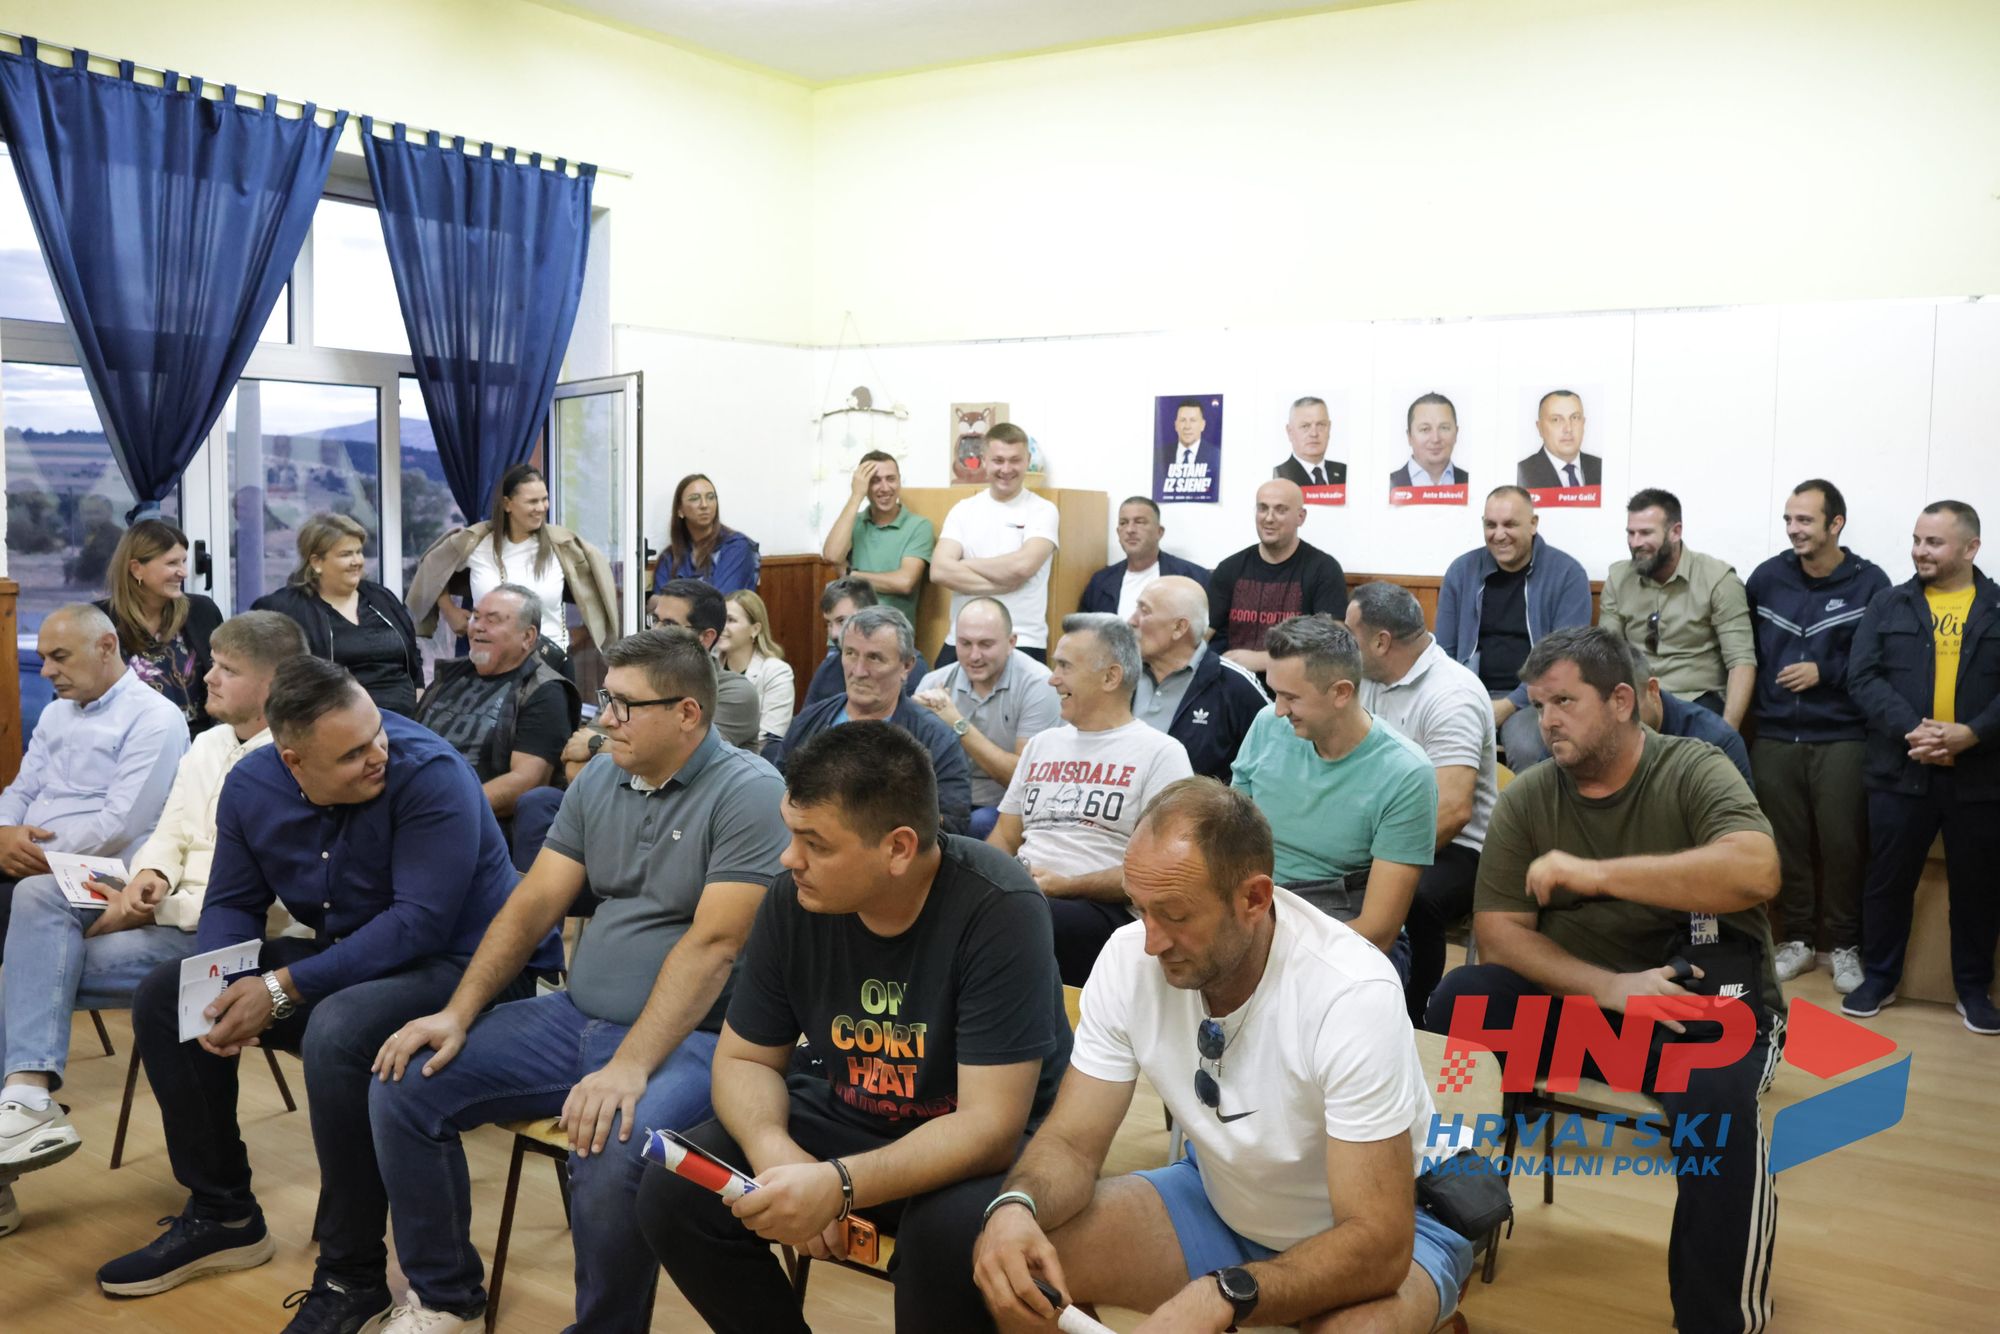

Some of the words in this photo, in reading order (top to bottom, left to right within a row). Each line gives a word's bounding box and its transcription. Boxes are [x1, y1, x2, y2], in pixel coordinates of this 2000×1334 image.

[1167, 463, 1208, 478] USTANI
[1163, 478, 1176, 492] IZ
[1025, 761, 1136, 787] LONSDALE
[1025, 788, 1040, 816] 9
[1083, 790, 1125, 822] 60
[1720, 984, 1744, 997] NIKE
[847, 1056, 917, 1099] HEAT
